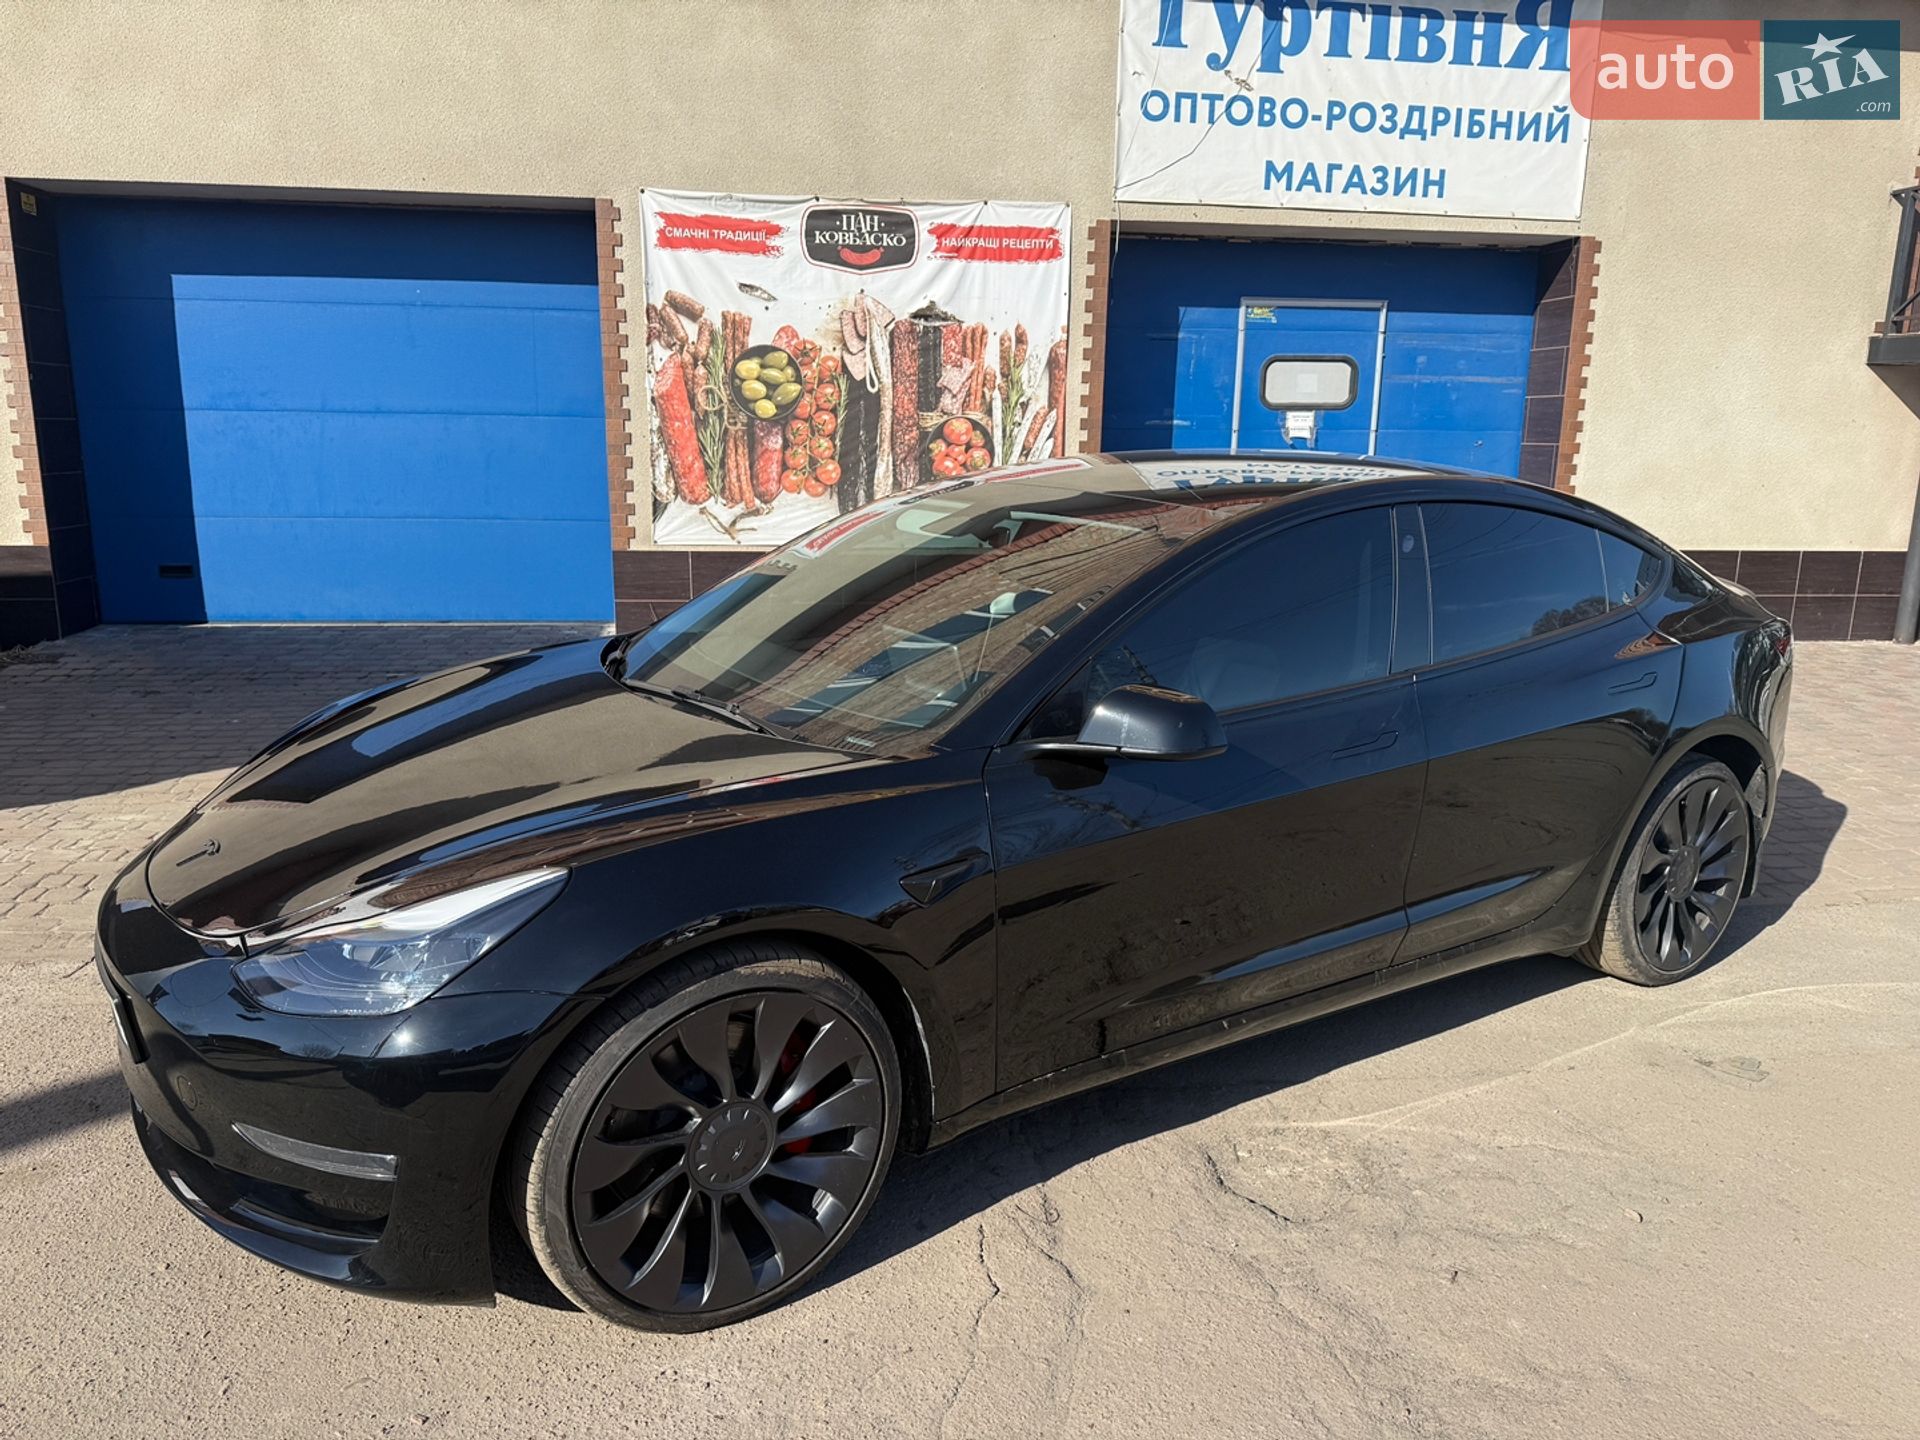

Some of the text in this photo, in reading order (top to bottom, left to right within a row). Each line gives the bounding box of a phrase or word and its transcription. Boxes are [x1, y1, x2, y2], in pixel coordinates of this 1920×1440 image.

[1140, 89, 1571, 143] ОПТОВО-РОЗДРІБНИЙ
[1263, 160, 1447, 199] МАГАЗИН
[664, 226, 767, 242] СМАЧНІ ТРАДИЦІЇ
[842, 212, 879, 236] ПАН
[814, 230, 907, 247] КОВБАСКО
[941, 235, 1054, 250] НАЙКРАЩІ РЕЦЕПТИ
